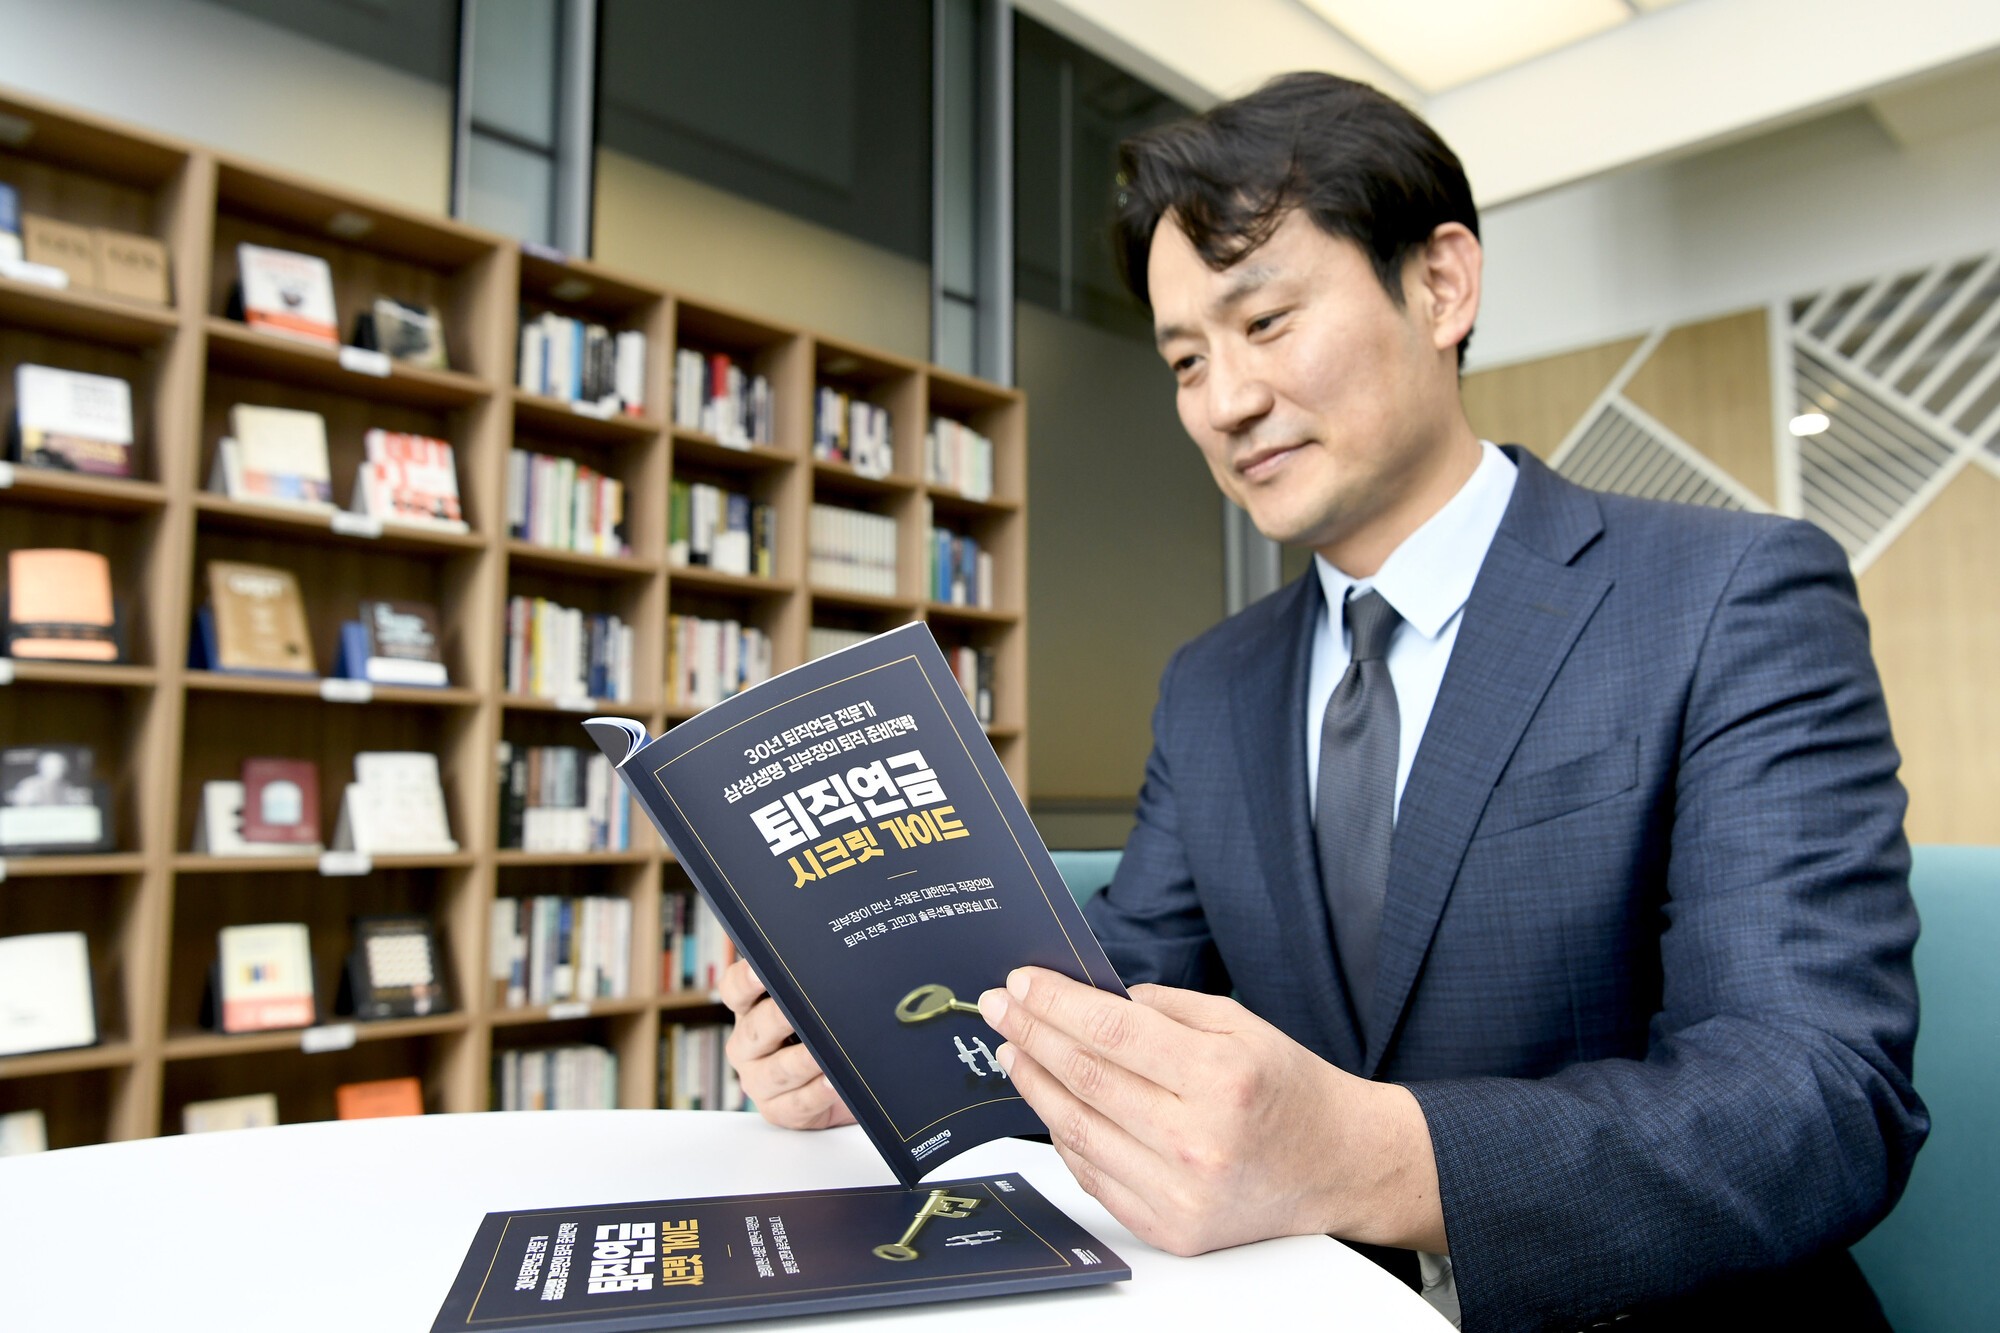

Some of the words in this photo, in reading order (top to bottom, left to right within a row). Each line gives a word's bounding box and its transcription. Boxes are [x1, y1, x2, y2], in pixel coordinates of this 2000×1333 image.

[723, 761, 786, 804] 삼성생명
[783, 738, 842, 773] 김부장의
[837, 729, 869, 752] 퇴직
[864, 714, 919, 743] 준비전략
[743, 734, 786, 765] 30년
[781, 714, 839, 748] 퇴직연금
[834, 700, 877, 727] 전문가
[749, 749, 948, 857] 퇴직연금
[787, 826, 885, 889] 시크릿
[877, 805, 971, 849] 가이드
[828, 906, 872, 933] 김부장이
[870, 899, 893, 915] 만난
[893, 890, 923, 907] 수많은
[920, 883, 959, 900] 대한민국
[956, 877, 995, 893] 직장인의
[843, 930, 868, 948] 퇴직
[865, 922, 889, 938] 전후
[887, 913, 919, 931] 고민과
[918, 905, 955, 922] 솔루션을
[952, 898, 1002, 915] 담았습니다.
[911, 1129, 952, 1156] Samsung
[587, 1222, 655, 1294] 퇴직연금
[662, 1219, 700, 1254] 가이드
[662, 1254, 704, 1286] 시크릿
